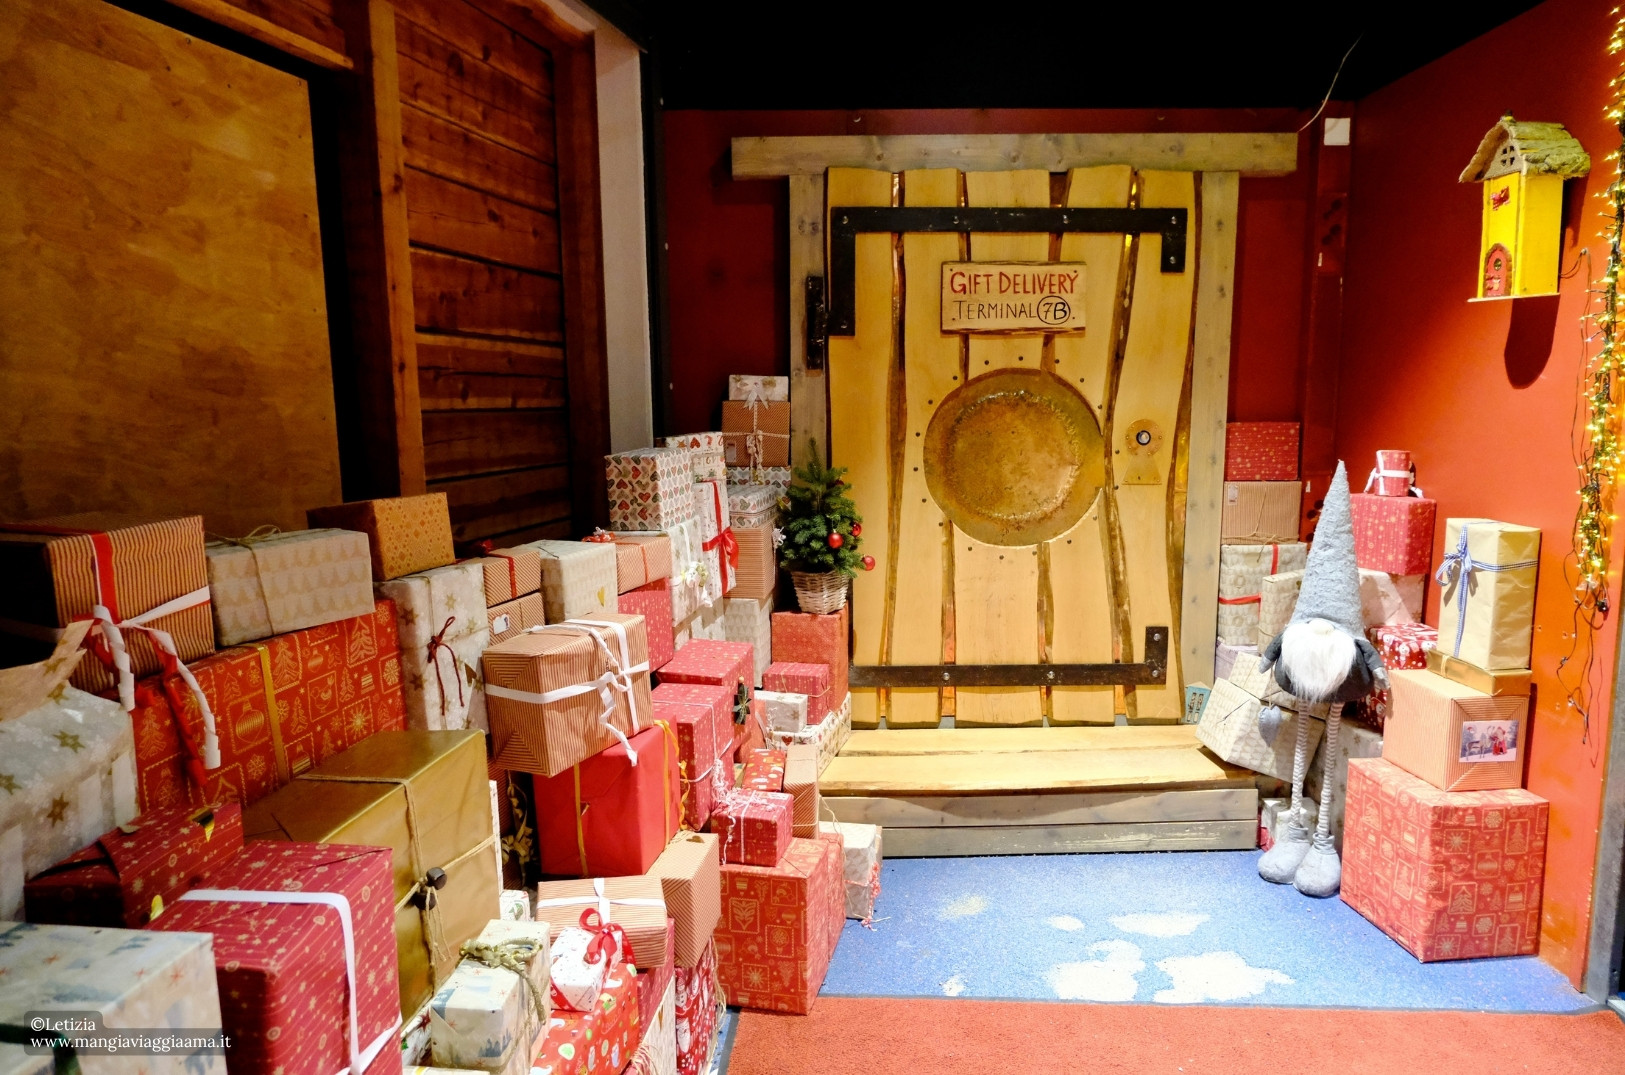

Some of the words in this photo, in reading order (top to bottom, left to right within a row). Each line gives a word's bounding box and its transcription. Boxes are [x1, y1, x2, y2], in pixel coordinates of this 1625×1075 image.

[950, 271, 994, 295] GIFT
[999, 271, 1079, 295] DELIVERY
[952, 300, 1037, 320] TERMINAL
[1042, 301, 1068, 321] 7B
